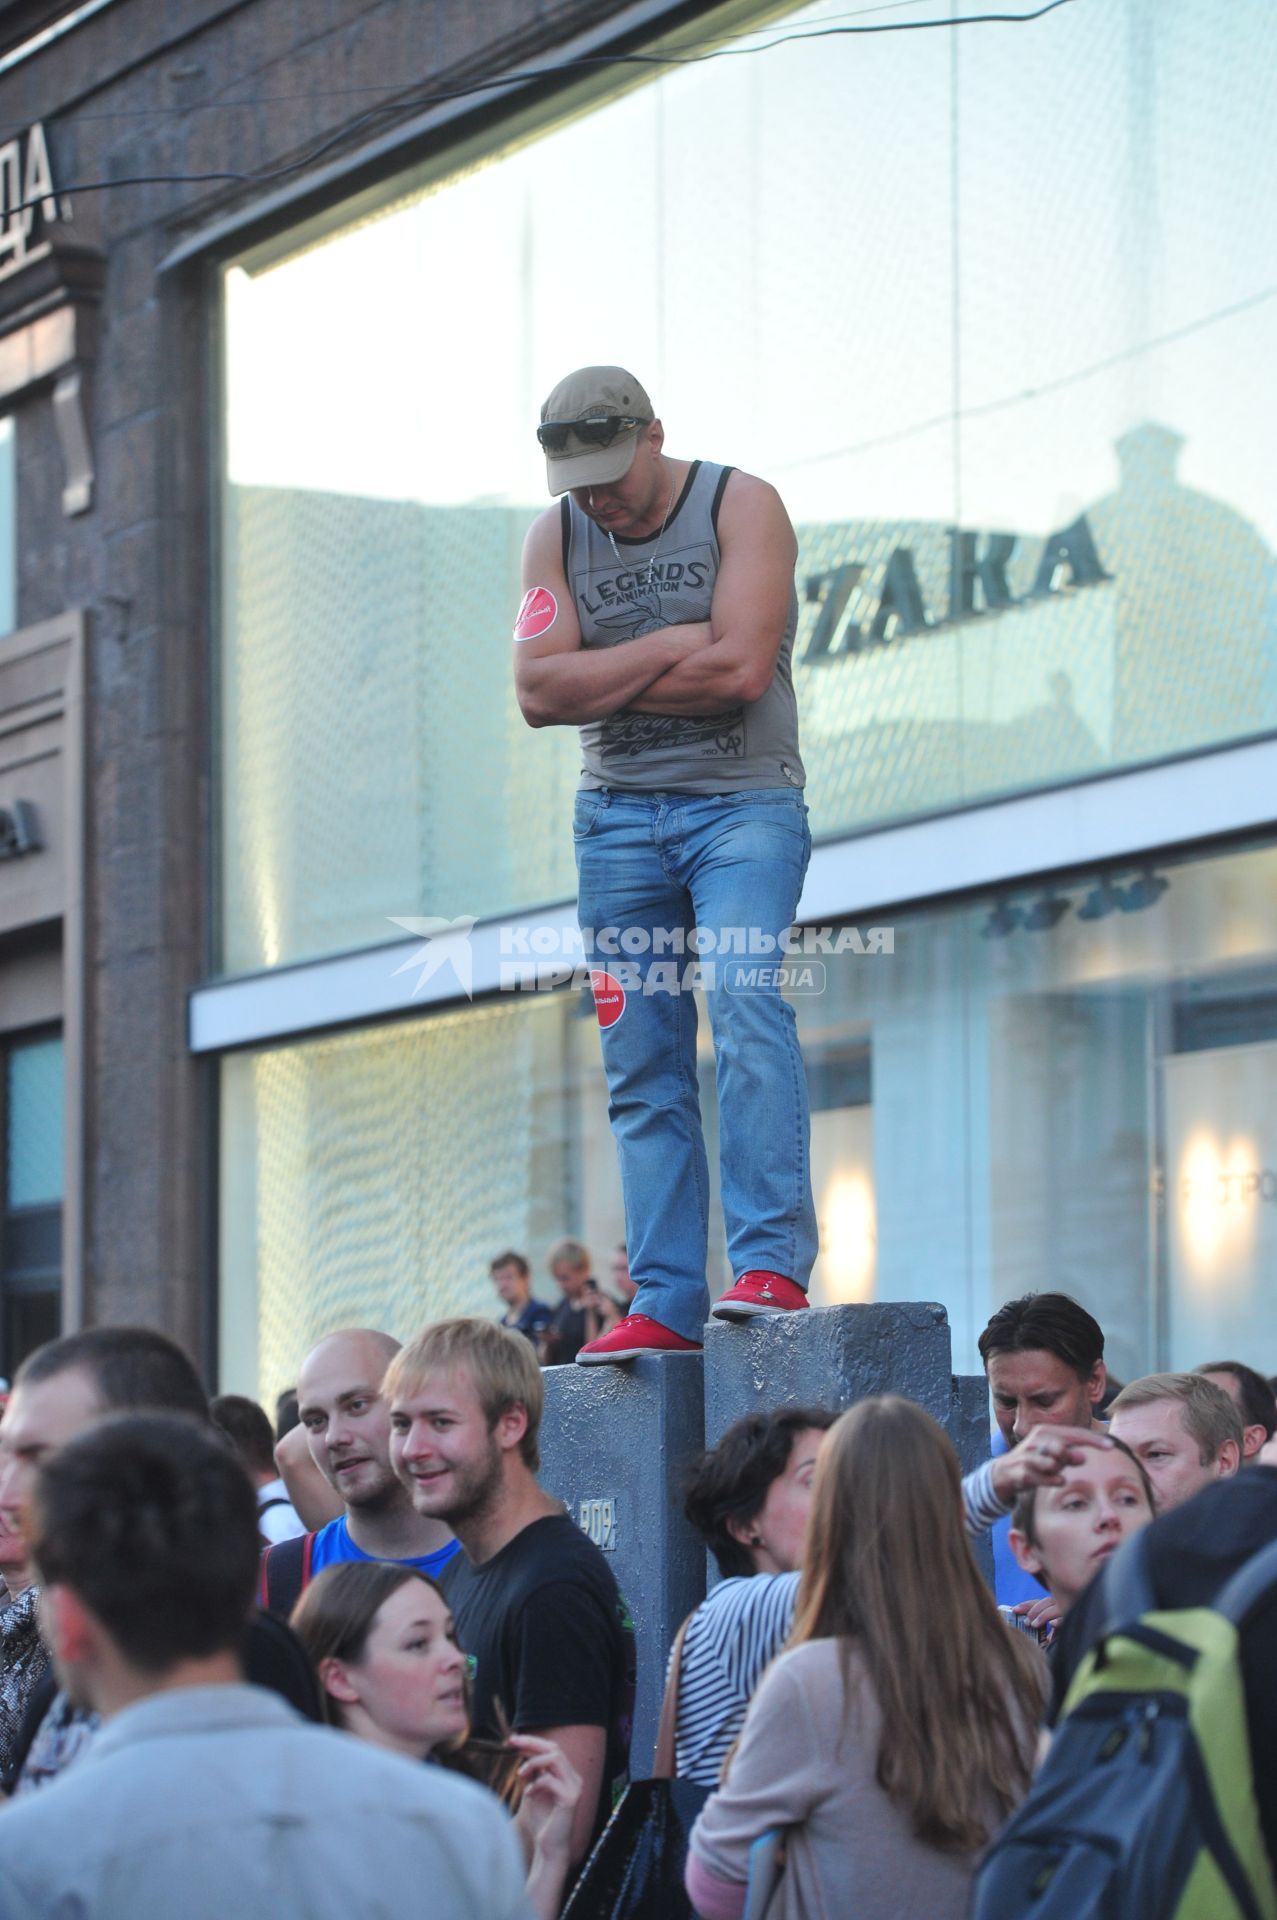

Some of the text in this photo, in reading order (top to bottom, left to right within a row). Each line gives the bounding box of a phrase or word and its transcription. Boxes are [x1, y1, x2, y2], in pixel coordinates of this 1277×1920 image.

[579, 562, 709, 615] LEGENDS
[616, 581, 680, 606] ANIMATION
[802, 514, 1115, 665] ZARA
